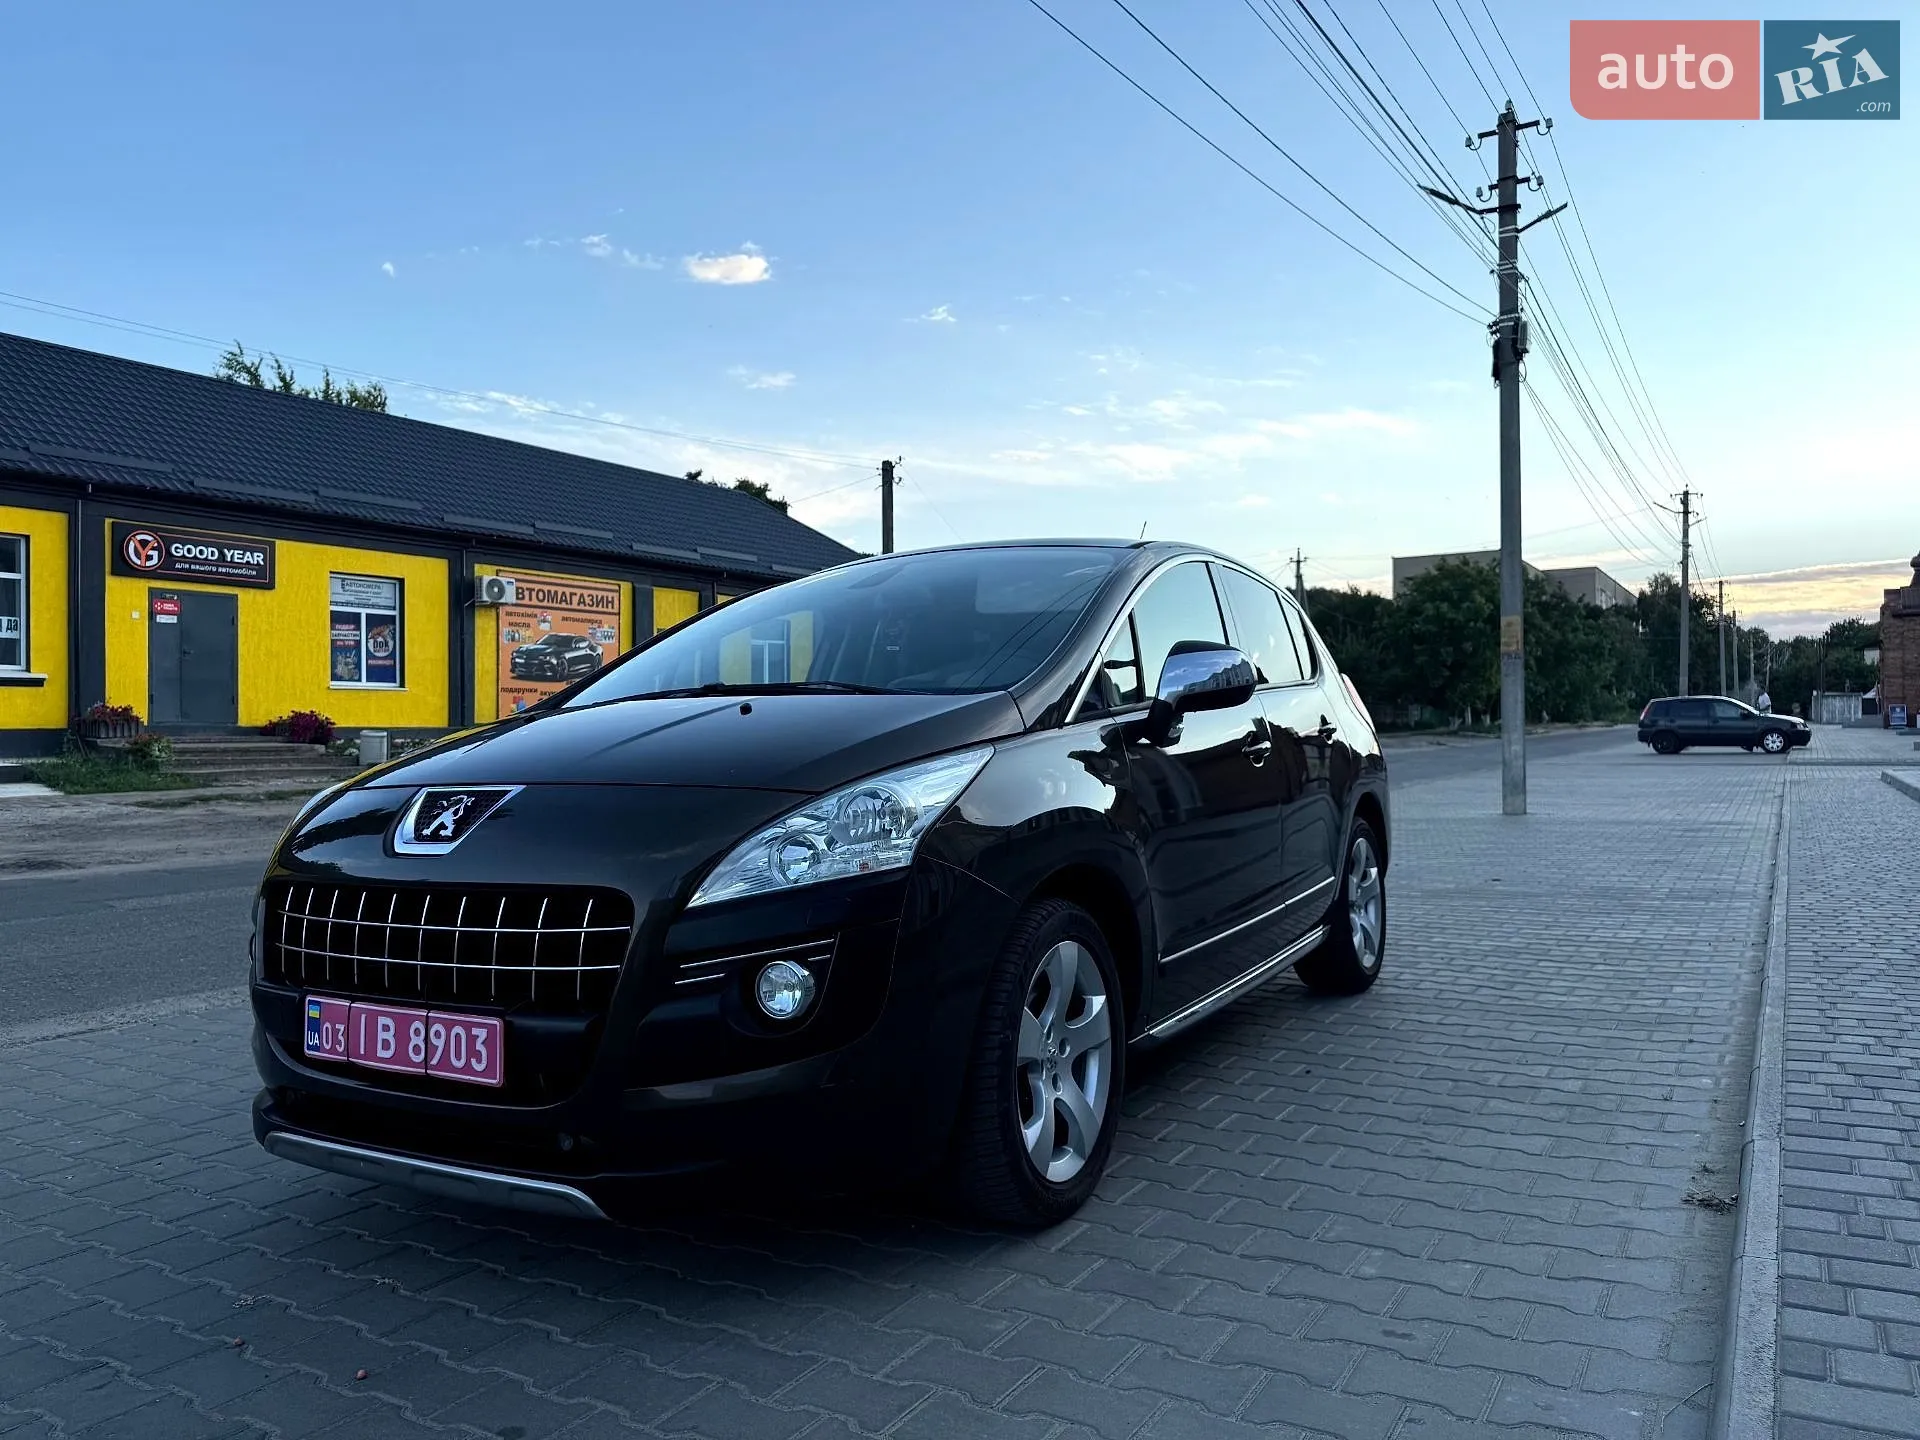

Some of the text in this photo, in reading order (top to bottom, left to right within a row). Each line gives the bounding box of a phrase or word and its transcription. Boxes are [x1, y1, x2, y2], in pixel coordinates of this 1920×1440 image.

[171, 543, 264, 565] GOOD YEAR
[515, 586, 615, 610] ВТОМАГАЗИН
[307, 1031, 320, 1047] UA
[322, 1021, 345, 1053] 03
[408, 1020, 488, 1073] 8903
